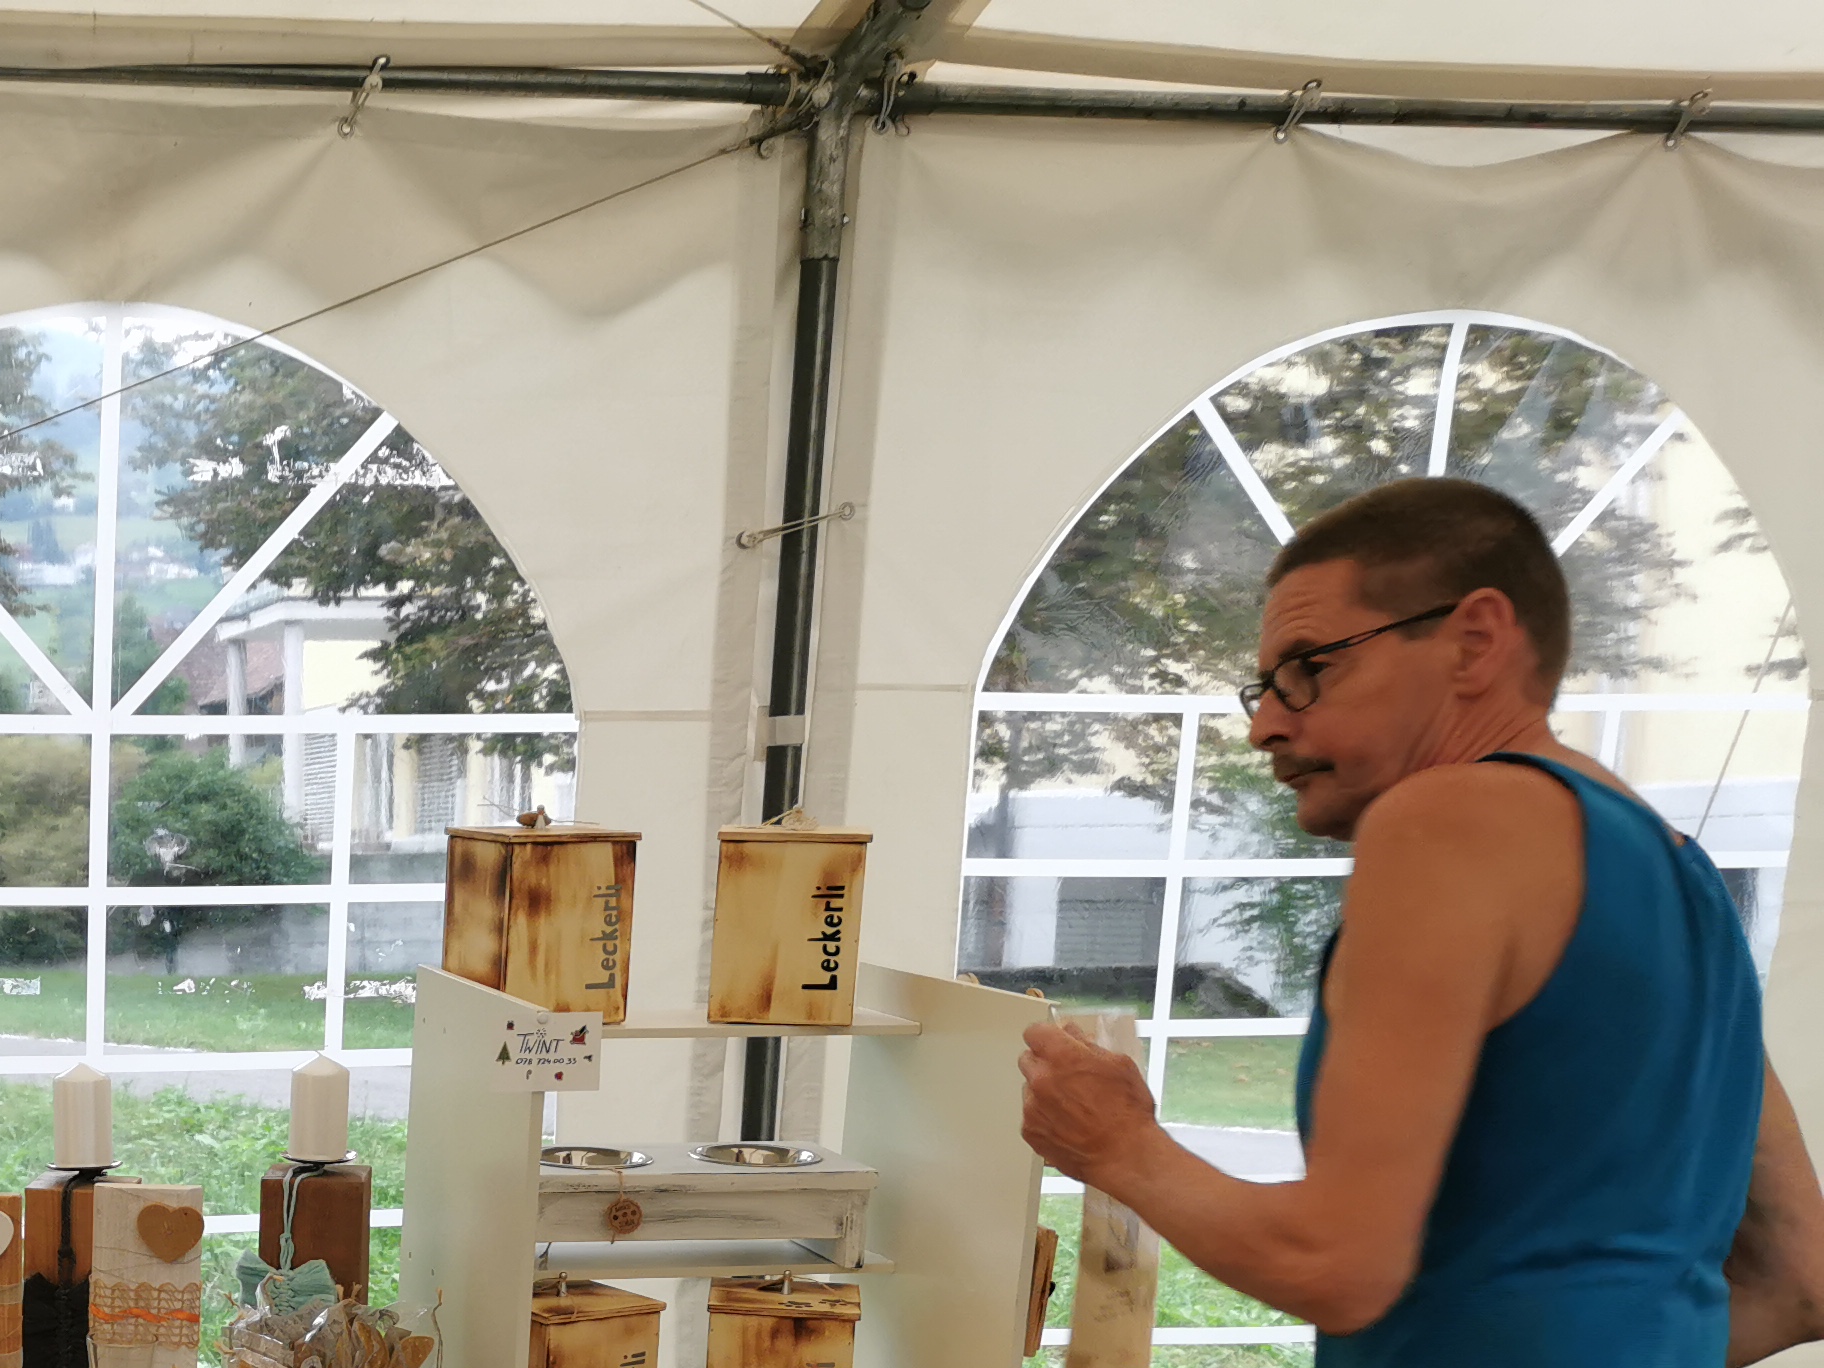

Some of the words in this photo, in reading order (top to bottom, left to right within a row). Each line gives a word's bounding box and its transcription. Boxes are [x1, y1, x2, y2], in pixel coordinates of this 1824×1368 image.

[585, 884, 623, 990] Leckerli
[801, 885, 846, 990] Leckerli
[517, 1032, 565, 1054] TWINT
